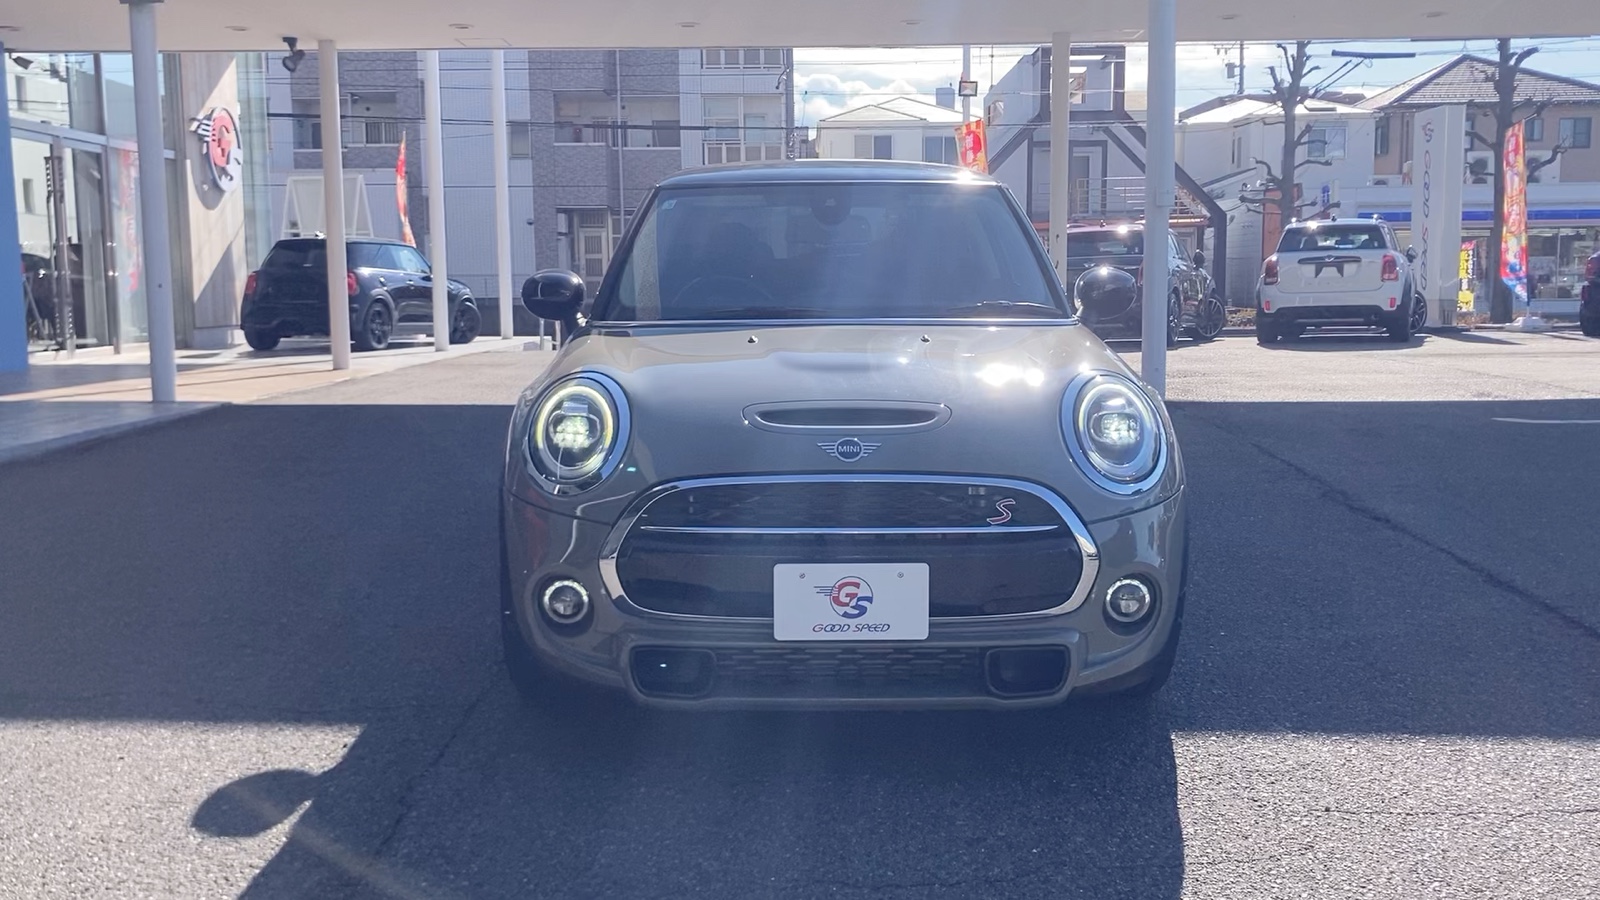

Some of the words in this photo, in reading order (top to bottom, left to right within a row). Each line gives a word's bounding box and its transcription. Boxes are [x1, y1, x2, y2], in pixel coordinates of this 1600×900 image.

[838, 445, 860, 453] MINI
[986, 498, 1016, 525] S
[812, 623, 850, 633] GOOD
[852, 623, 890, 633] SPEED
